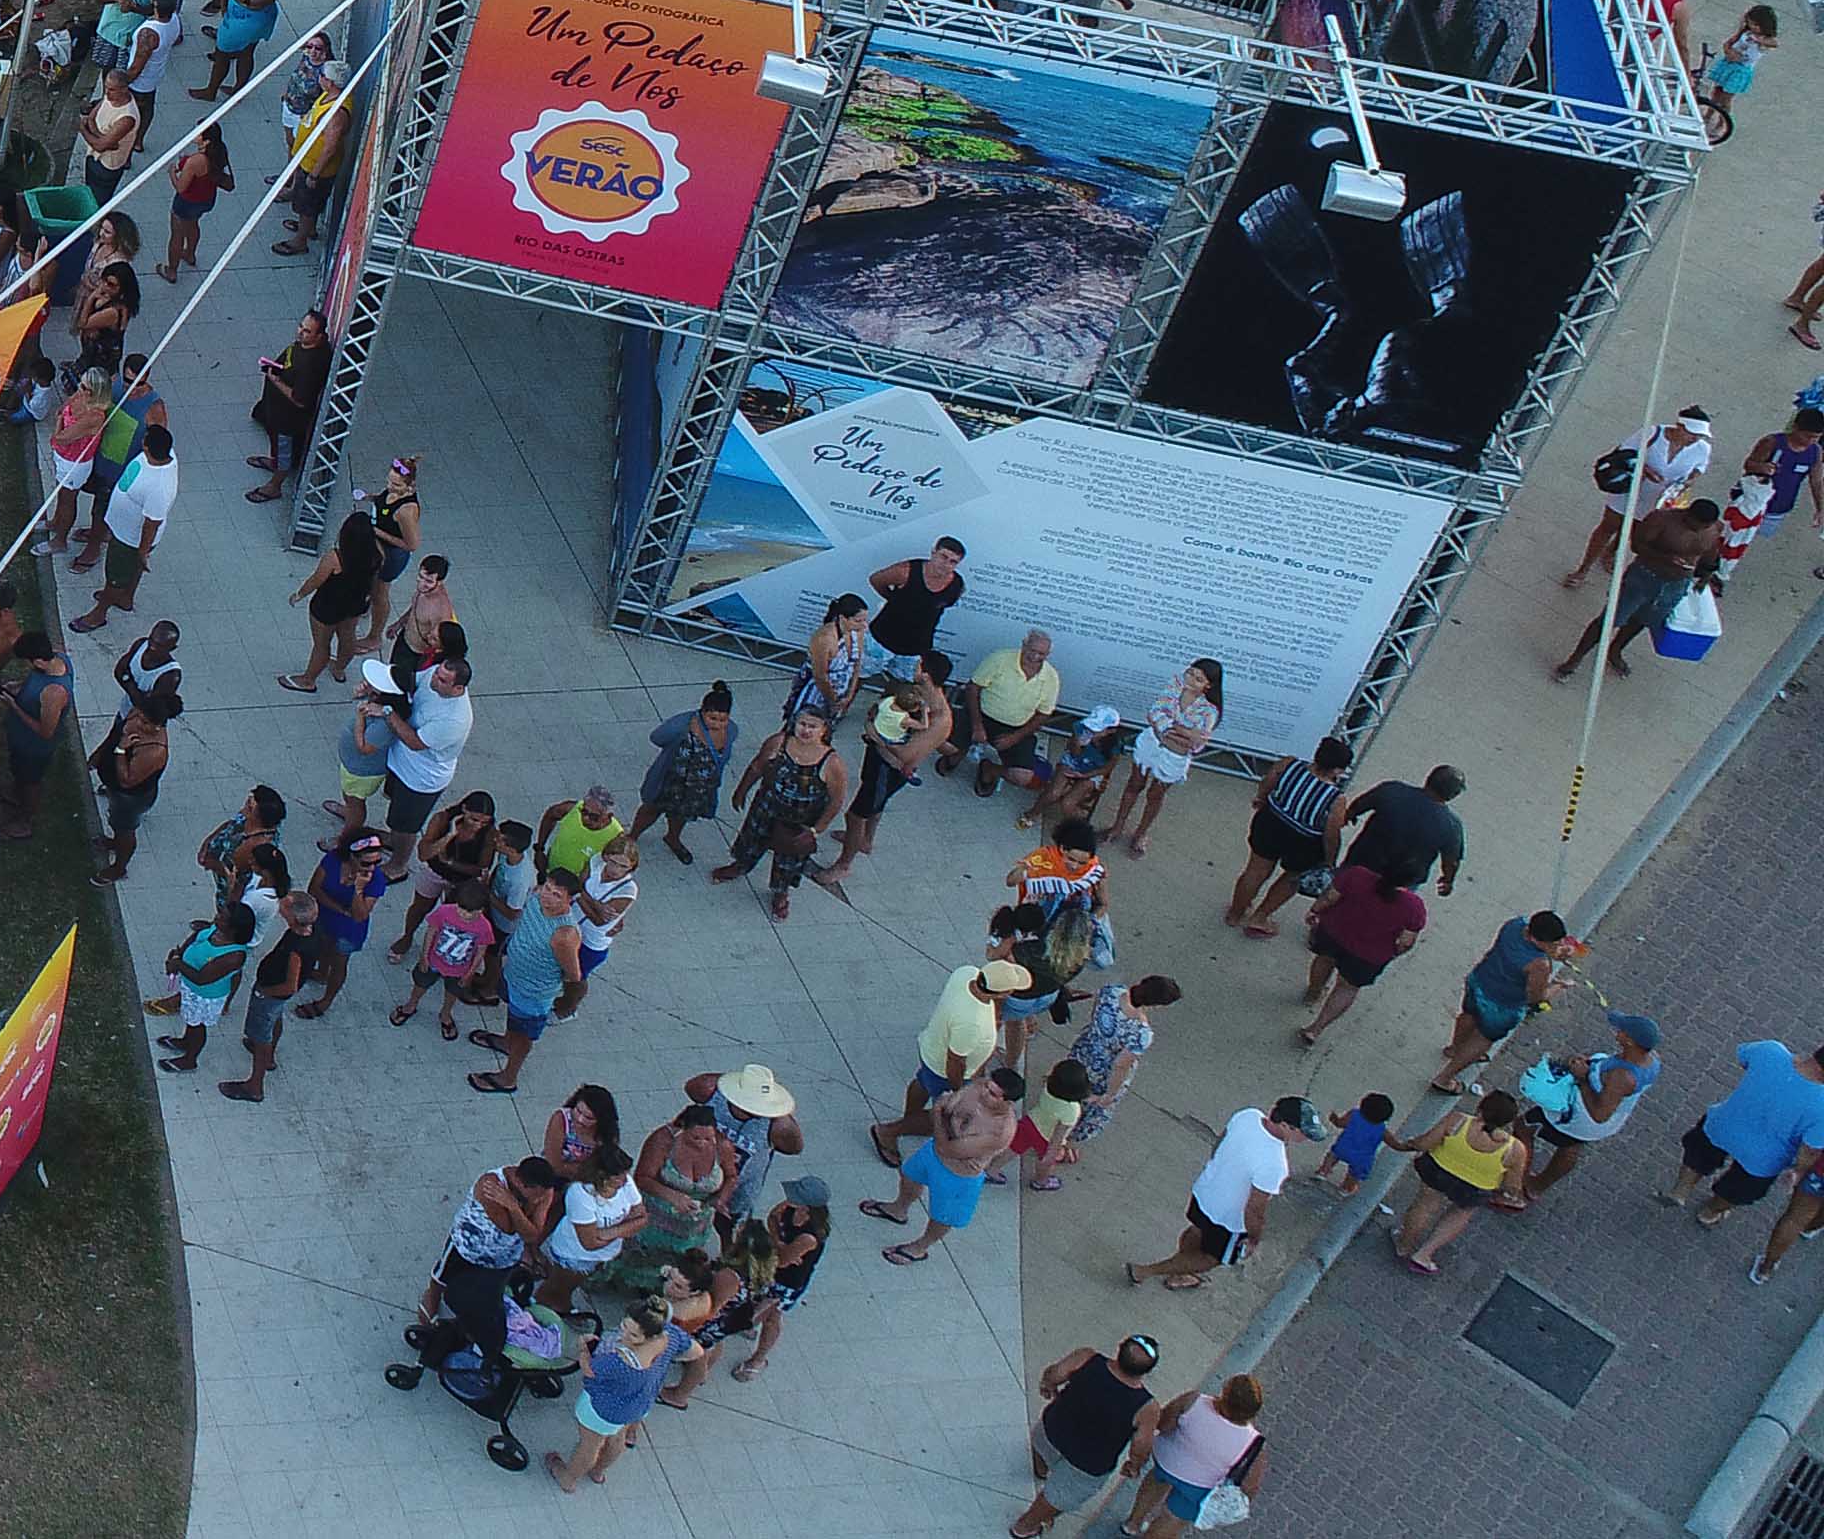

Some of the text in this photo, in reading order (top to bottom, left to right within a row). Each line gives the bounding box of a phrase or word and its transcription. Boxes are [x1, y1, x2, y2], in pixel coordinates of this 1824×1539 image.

[643, 4, 725, 28] FOTOGRÁFICA
[527, 6, 749, 77] Um Pedaço
[550, 55, 597, 89] de
[579, 136, 626, 157] Sesc
[525, 150, 664, 202] VERÃO
[514, 234, 539, 248] RIO
[542, 240, 571, 255] DAS
[574, 246, 625, 266] OSTRAS
[842, 426, 886, 453] Um
[813, 444, 944, 489] Pedaço de
[1180, 534, 1225, 552] Como
[1235, 547, 1281, 564] bonito
[1280, 557, 1305, 570] Rio
[1303, 562, 1332, 576] das
[1330, 568, 1375, 586] Ostras
